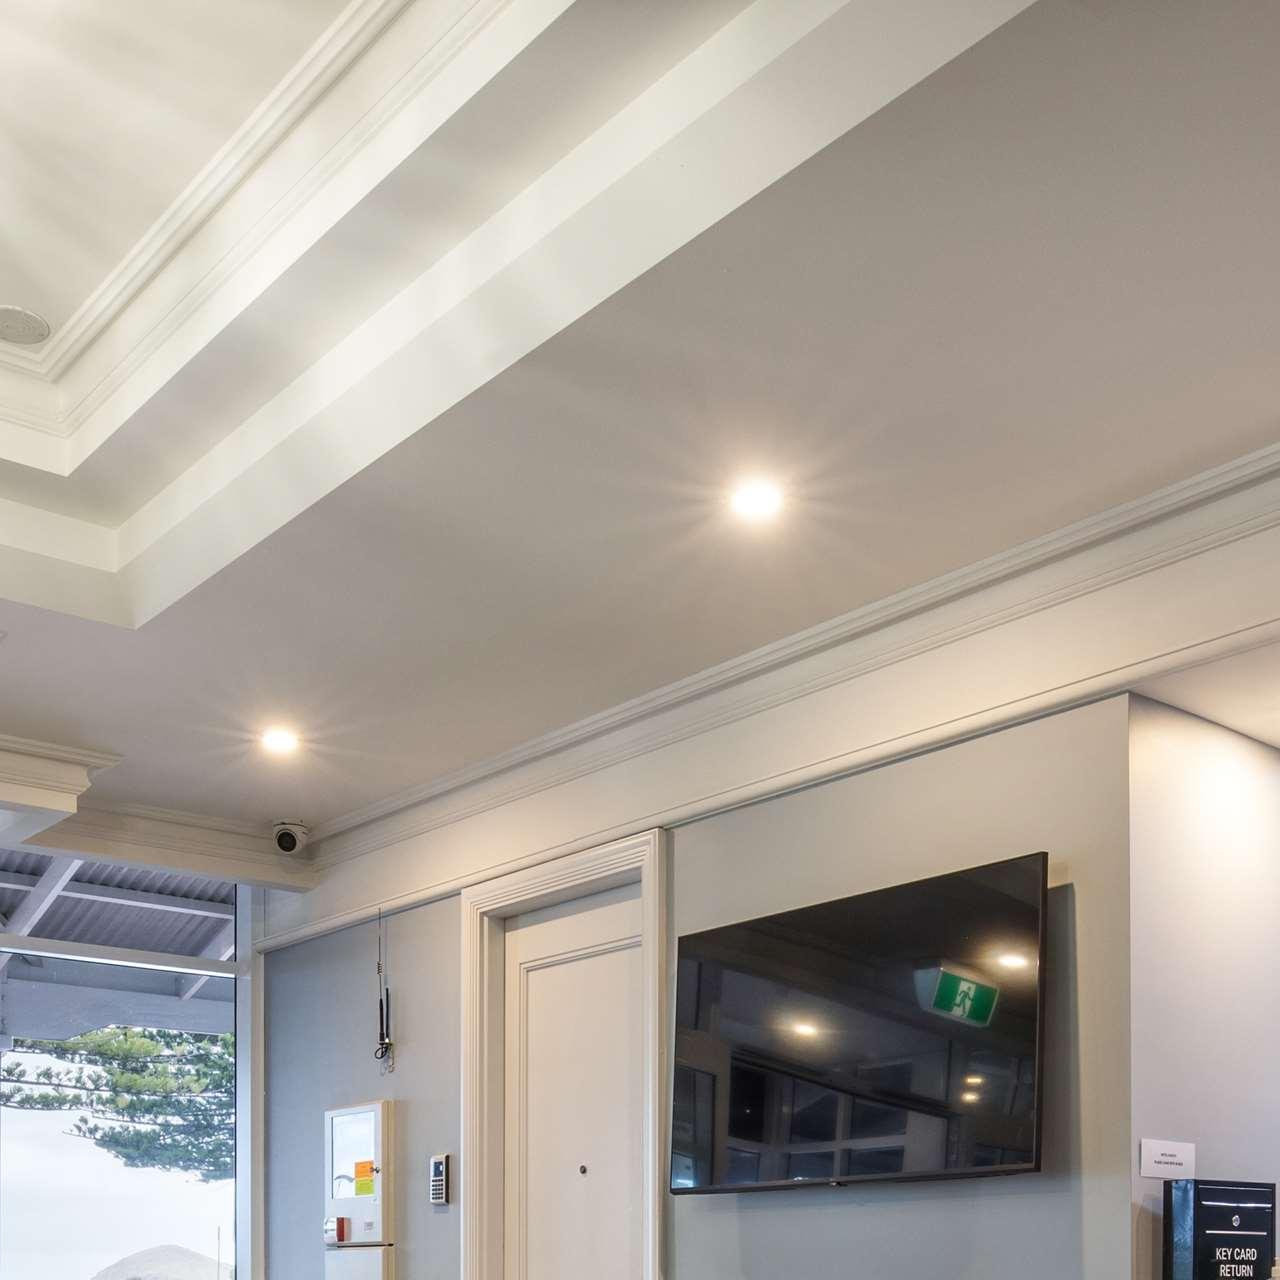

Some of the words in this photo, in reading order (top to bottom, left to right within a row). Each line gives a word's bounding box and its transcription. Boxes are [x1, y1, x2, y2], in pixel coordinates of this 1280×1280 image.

[1215, 1247, 1233, 1260] KEY
[1234, 1248, 1257, 1261] CARD
[1220, 1264, 1254, 1277] RETURN
